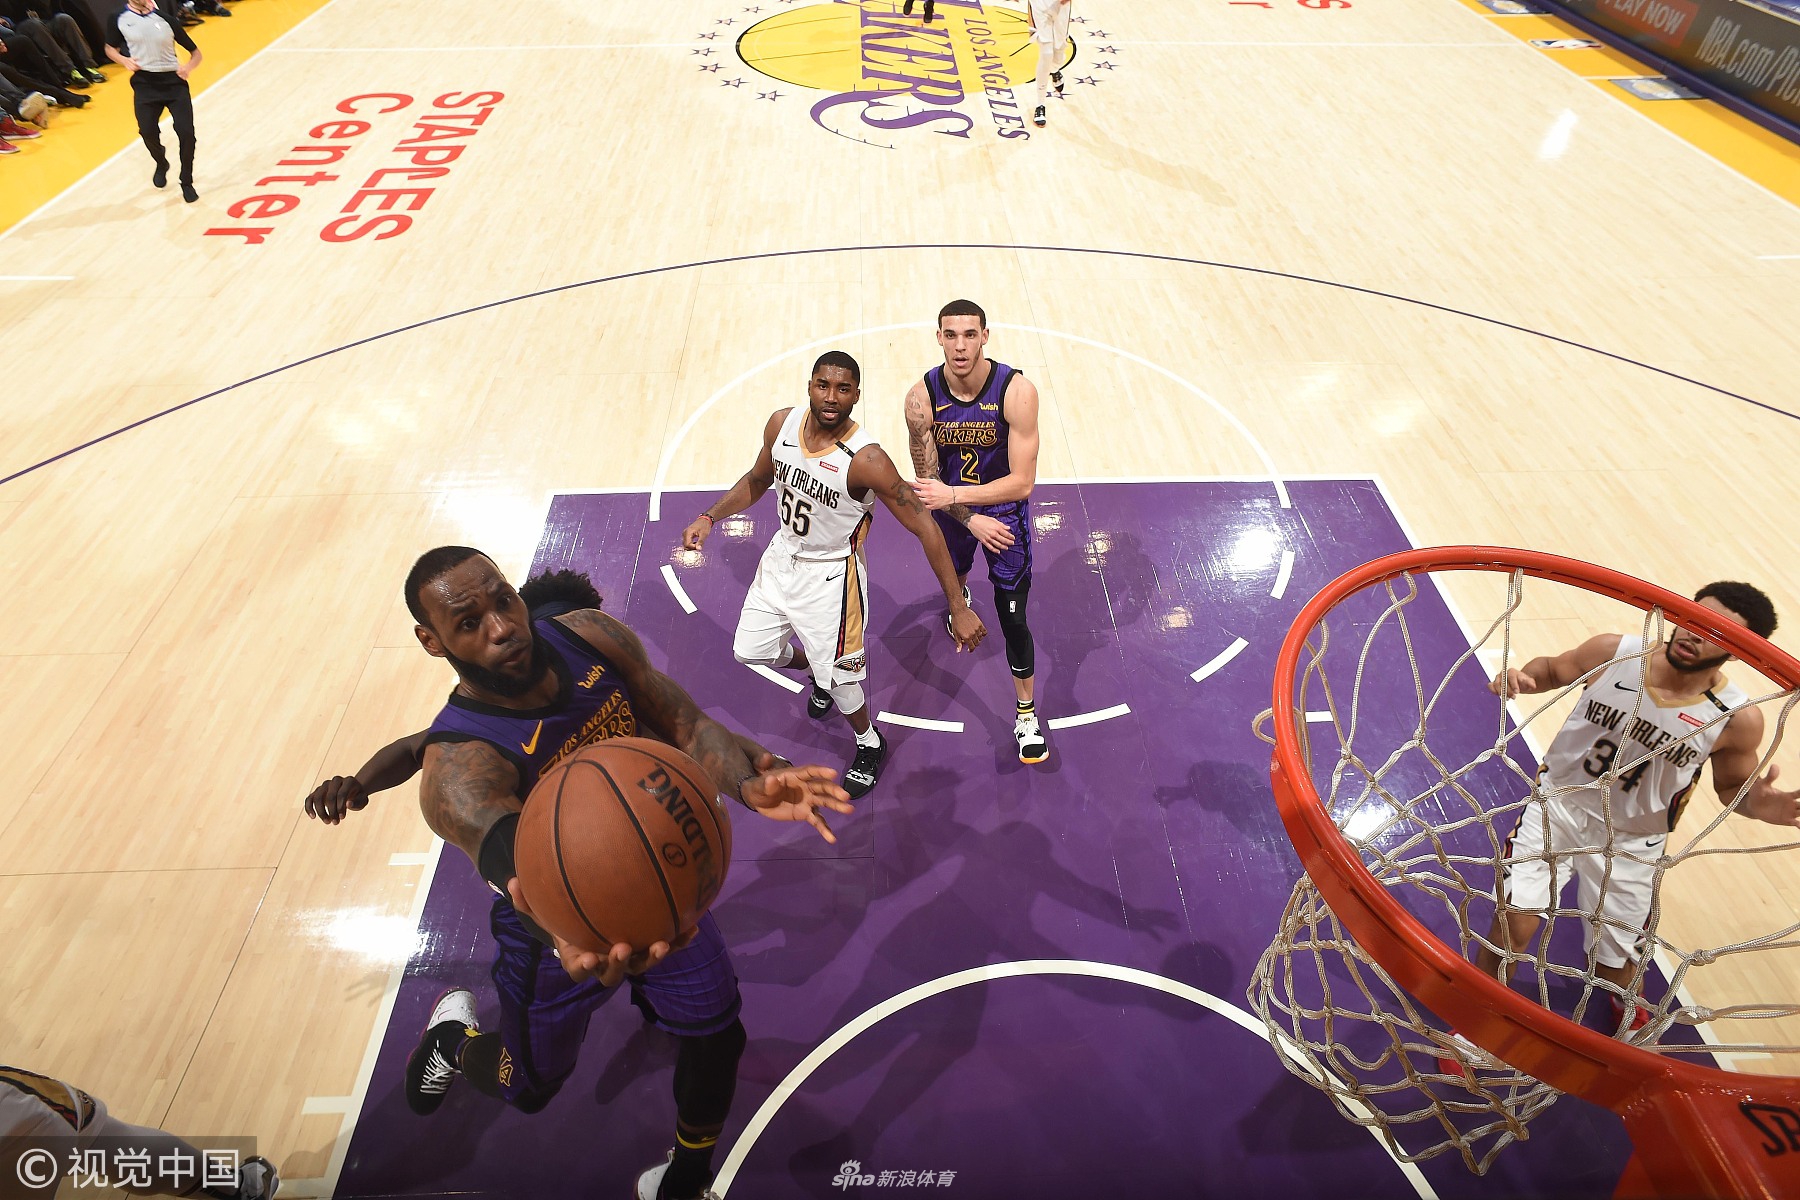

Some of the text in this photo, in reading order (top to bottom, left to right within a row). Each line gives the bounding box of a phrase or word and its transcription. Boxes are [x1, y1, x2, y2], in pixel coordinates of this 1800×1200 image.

[1642, 2, 1686, 35] NOW
[964, 17, 1031, 141] LOS ANGELES
[203, 92, 414, 245] Center
[319, 90, 505, 243] STAPLES
[979, 403, 999, 411] wish
[933, 421, 998, 447] LAKERS
[773, 458, 840, 509] EW ORLEANS
[960, 446, 981, 485] 2
[781, 487, 813, 537] 55
[577, 664, 606, 689] wish
[581, 689, 622, 737] ANGELES
[1584, 699, 1627, 731] NEW
